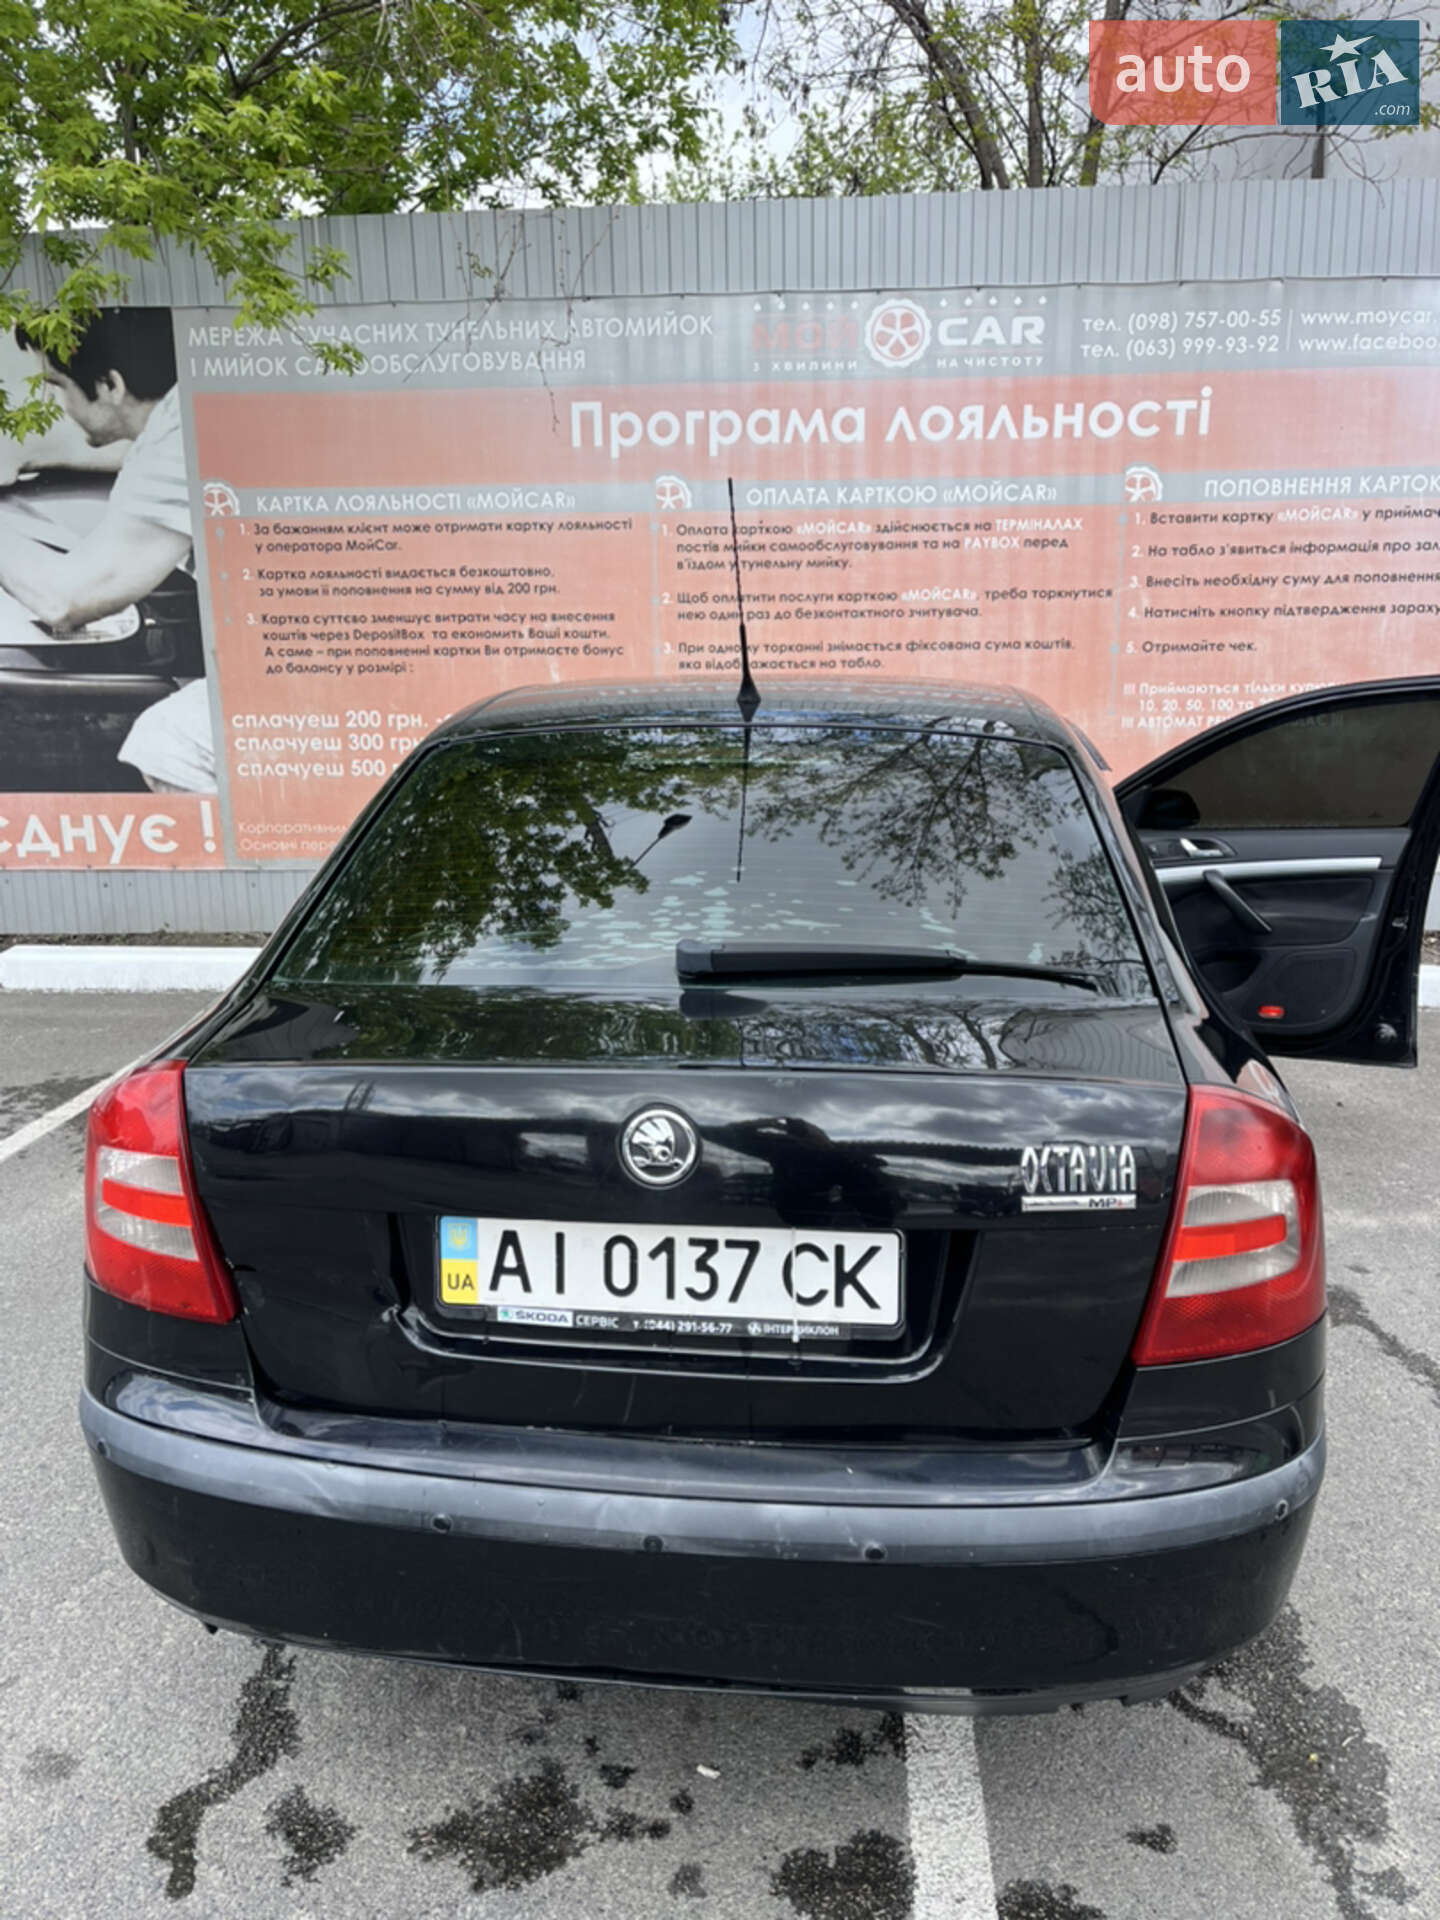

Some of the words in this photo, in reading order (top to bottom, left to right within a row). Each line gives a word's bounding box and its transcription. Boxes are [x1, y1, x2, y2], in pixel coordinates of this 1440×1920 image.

[188, 324, 284, 347] МЕРЕЖА
[291, 322, 418, 346] СУЧАСНИХ
[425, 319, 555, 342] ТУНЕЛЬНИХ
[566, 311, 713, 338] АВТОМИЙОК
[937, 315, 1046, 346] CAR
[1082, 317, 1121, 332] тел.
[1128, 312, 1178, 335] (098)
[1184, 309, 1282, 328] 757-00-55
[1080, 342, 1120, 358] тел.
[1125, 337, 1176, 360] (063)
[1183, 335, 1280, 355] 999-93-92
[204, 352, 289, 377] МИЙОК
[295, 350, 586, 376] САООБСЛУГОВУВАННЯ
[772, 360, 858, 372] ХВИЛИНИ
[937, 358, 958, 369] НА
[964, 356, 1045, 368] ЧИСТОТУ
[571, 400, 865, 459] Програма
[885, 386, 1212, 440] лояльності
[746, 487, 830, 505] ОПЛАТА
[836, 484, 937, 504] КАРТКОЮ
[1204, 478, 1352, 497] ПОПОВНЕННЯ
[256, 495, 330, 512] КАРТКА
[335, 491, 462, 512] ЛОЯЛЬНОСТІ
[1150, 511, 1219, 525] Вставити
[1222, 510, 1275, 526] картку
[1362, 508, 1371, 521] у
[254, 523, 269, 535] За
[273, 522, 343, 535] бажанням
[347, 521, 389, 534] клієнт
[392, 523, 430, 534] може
[435, 521, 503, 534] отримати
[506, 520, 554, 534] картку
[558, 518, 633, 531] лояльності
[676, 523, 728, 536] Оплата
[875, 520, 970, 534] здійснюється
[974, 521, 992, 532] на
[995, 518, 1083, 532] ТЕРМІНАЛАХ
[255, 541, 263, 553] у
[266, 540, 343, 553] оператора
[677, 540, 720, 553] постів
[769, 538, 918, 554] самообслуговування
[923, 539, 938, 550] та
[942, 539, 960, 549] на
[964, 536, 1020, 549] PAYBOX
[1023, 537, 1068, 550] перед
[1148, 544, 1168, 557] На
[1172, 543, 1216, 557] табло
[1219, 541, 1287, 555] з'явиться
[1290, 539, 1379, 555] інформація
[1383, 540, 1411, 555] про
[741, 559, 801, 572] тунельну
[806, 556, 852, 571] мийку.
[257, 568, 307, 582] Картка
[309, 566, 382, 580] лояльності
[385, 567, 456, 580] видається
[1145, 575, 1200, 588] Внесіть
[1203, 572, 1279, 588] необхідну
[1282, 573, 1321, 588] суму
[1324, 572, 1350, 585] для
[1353, 571, 1440, 584] поповнення
[260, 586, 274, 597] за
[276, 586, 319, 598] умови
[332, 585, 412, 598] поповнення
[415, 585, 432, 596] на
[436, 585, 481, 597] сумму
[484, 582, 504, 595] від
[507, 582, 531, 594] 200
[533, 583, 560, 596] грн.
[677, 592, 709, 605] Щоб
[779, 592, 834, 606] послуги
[837, 590, 897, 604] карткою
[985, 587, 1028, 601] треба
[1032, 588, 1113, 602] торкнутися
[261, 613, 310, 626] Картка
[313, 613, 368, 626] суттєво
[370, 613, 431, 626] зменшує
[434, 612, 490, 625] витрати
[493, 611, 527, 624] часу
[530, 612, 547, 622] на
[550, 611, 615, 622] внесення
[677, 610, 706, 621] нею
[709, 609, 741, 621] один
[746, 610, 771, 623] раз
[774, 609, 792, 621] до
[795, 606, 904, 621] безконтактного
[1144, 604, 1216, 619] Натисніть
[1219, 605, 1270, 619] кнопку
[1274, 602, 1387, 617] підтвердження
[263, 628, 308, 641] коштів
[310, 630, 350, 642] через
[353, 628, 425, 642] DepositBox
[432, 630, 448, 640] та
[451, 629, 525, 640] економить
[528, 627, 561, 639] Ваші
[278, 647, 313, 658] саме
[326, 647, 352, 659] при
[355, 644, 430, 658] поповненні
[433, 645, 481, 658] картки
[484, 645, 500, 656] Ви
[503, 644, 580, 658] отримаєте
[583, 643, 624, 657] бонус
[678, 642, 705, 655] При
[764, 640, 824, 654] торканні
[827, 640, 901, 654] знімається
[906, 639, 981, 654] фіксована
[985, 640, 1021, 653] сума
[1024, 638, 1074, 651] коштів.
[1141, 639, 1226, 654] Отримайте
[1228, 641, 1258, 652] чек.
[266, 663, 283, 675] до
[286, 661, 342, 675] балансу
[346, 664, 354, 675] у
[358, 661, 407, 675] розмірі
[679, 660, 702, 670] яка
[705, 658, 815, 671] відобажається
[819, 658, 837, 669] на
[1139, 681, 1240, 697] Приймаються
[1244, 680, 1286, 695] тільки
[1211, 699, 1233, 712] 100
[344, 710, 382, 729] 200
[387, 713, 428, 731] грн.
[1137, 715, 1203, 729] АВТОМАТ
[348, 733, 384, 751] 300
[350, 759, 385, 777] 500
[0, 813, 178, 865] днує
[240, 839, 298, 854] Основні
[1020, 1144, 1137, 1194] OCTAVIA
[489, 1229, 566, 1294] AI
[603, 1234, 761, 1304] 0137
[781, 1242, 883, 1310] CK
[447, 1273, 475, 1290] UA
[575, 1314, 619, 1329] СЕРВІС
